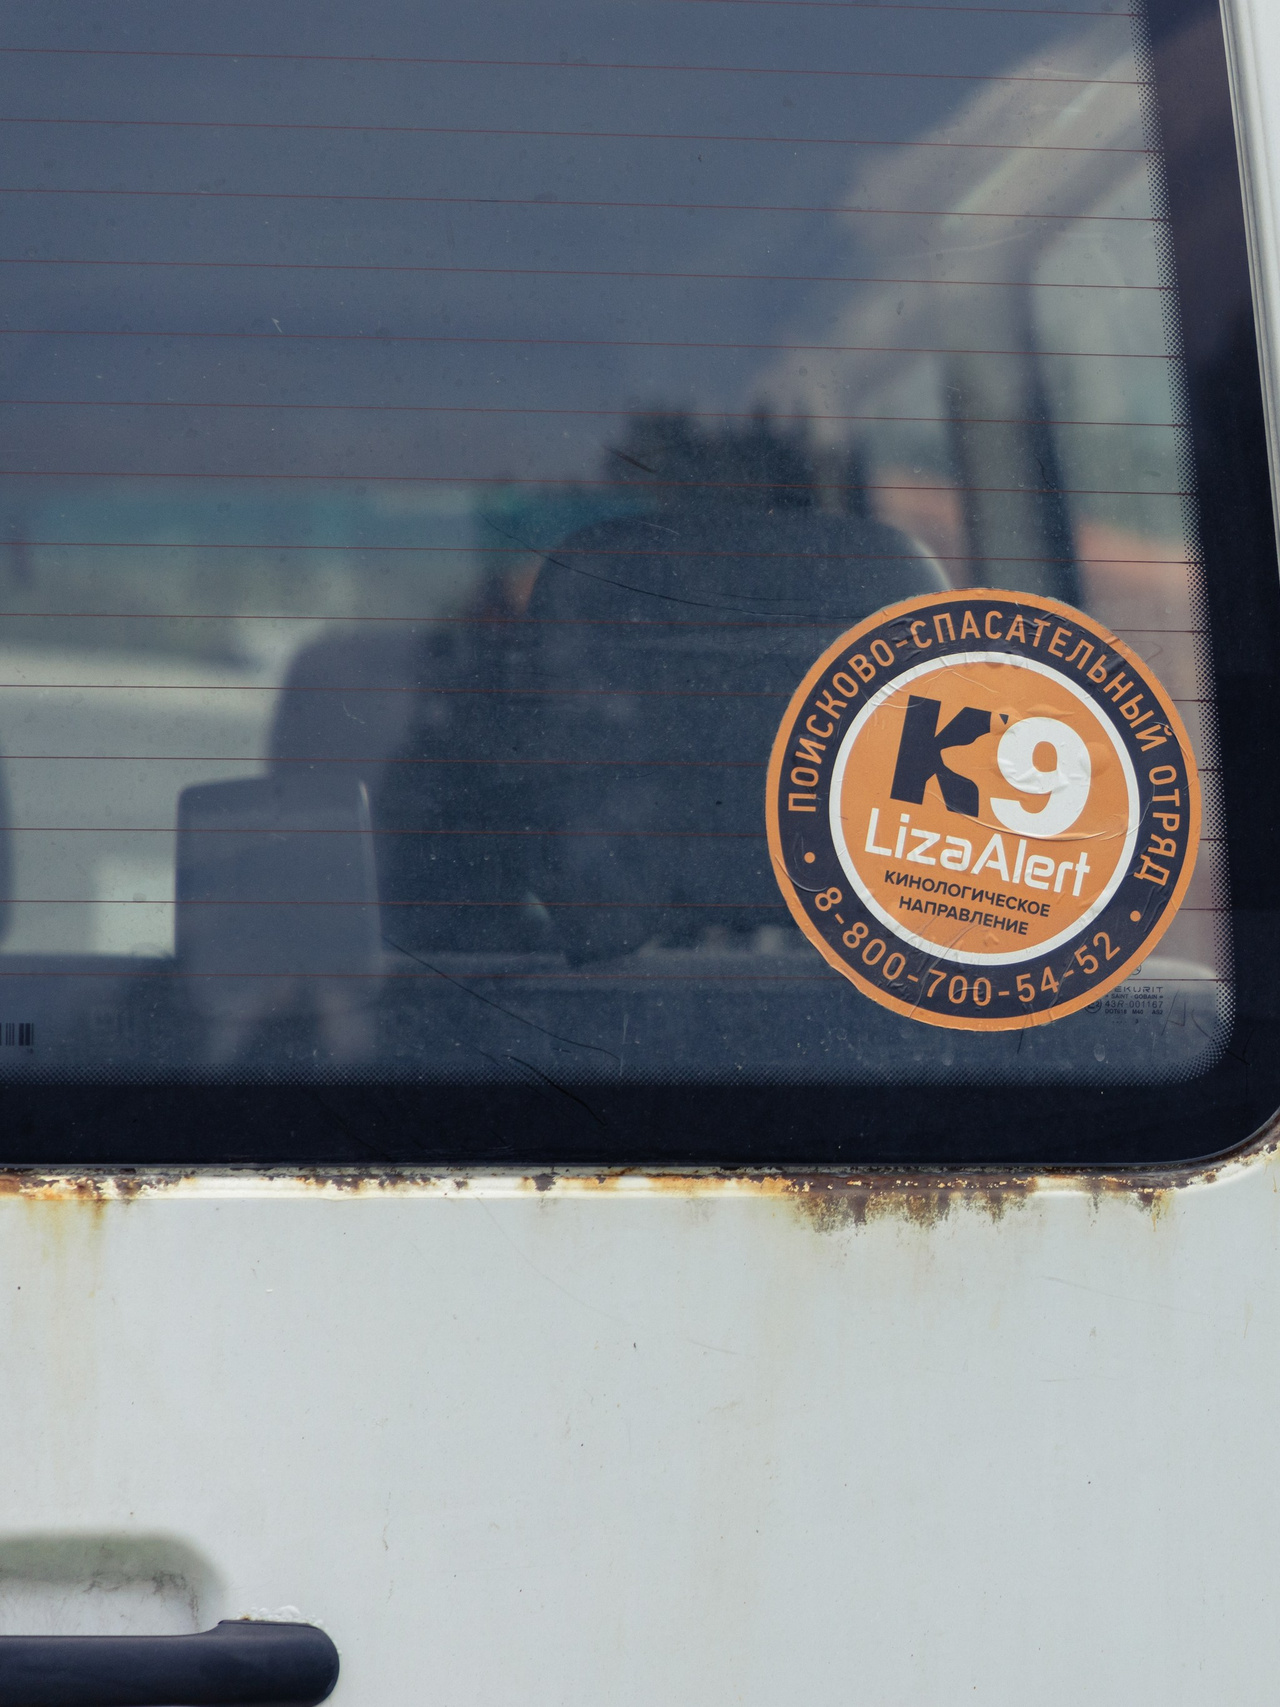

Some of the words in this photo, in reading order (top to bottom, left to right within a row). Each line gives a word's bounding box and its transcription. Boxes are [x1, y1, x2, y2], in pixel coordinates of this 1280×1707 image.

[787, 610, 1174, 813] ПОИСКОВО-СПАСАТЕЛЬНЫЙ
[1133, 763, 1181, 886] ОТРЯД
[889, 694, 1092, 838] K9
[864, 806, 1091, 897] LizaAlert
[884, 870, 1051, 918] КИНОЛОГИЧЕСКОЕ
[814, 886, 1121, 1006] 8-800-700-54-52
[898, 896, 1030, 936] НАПРАВЛЕНИЕ
